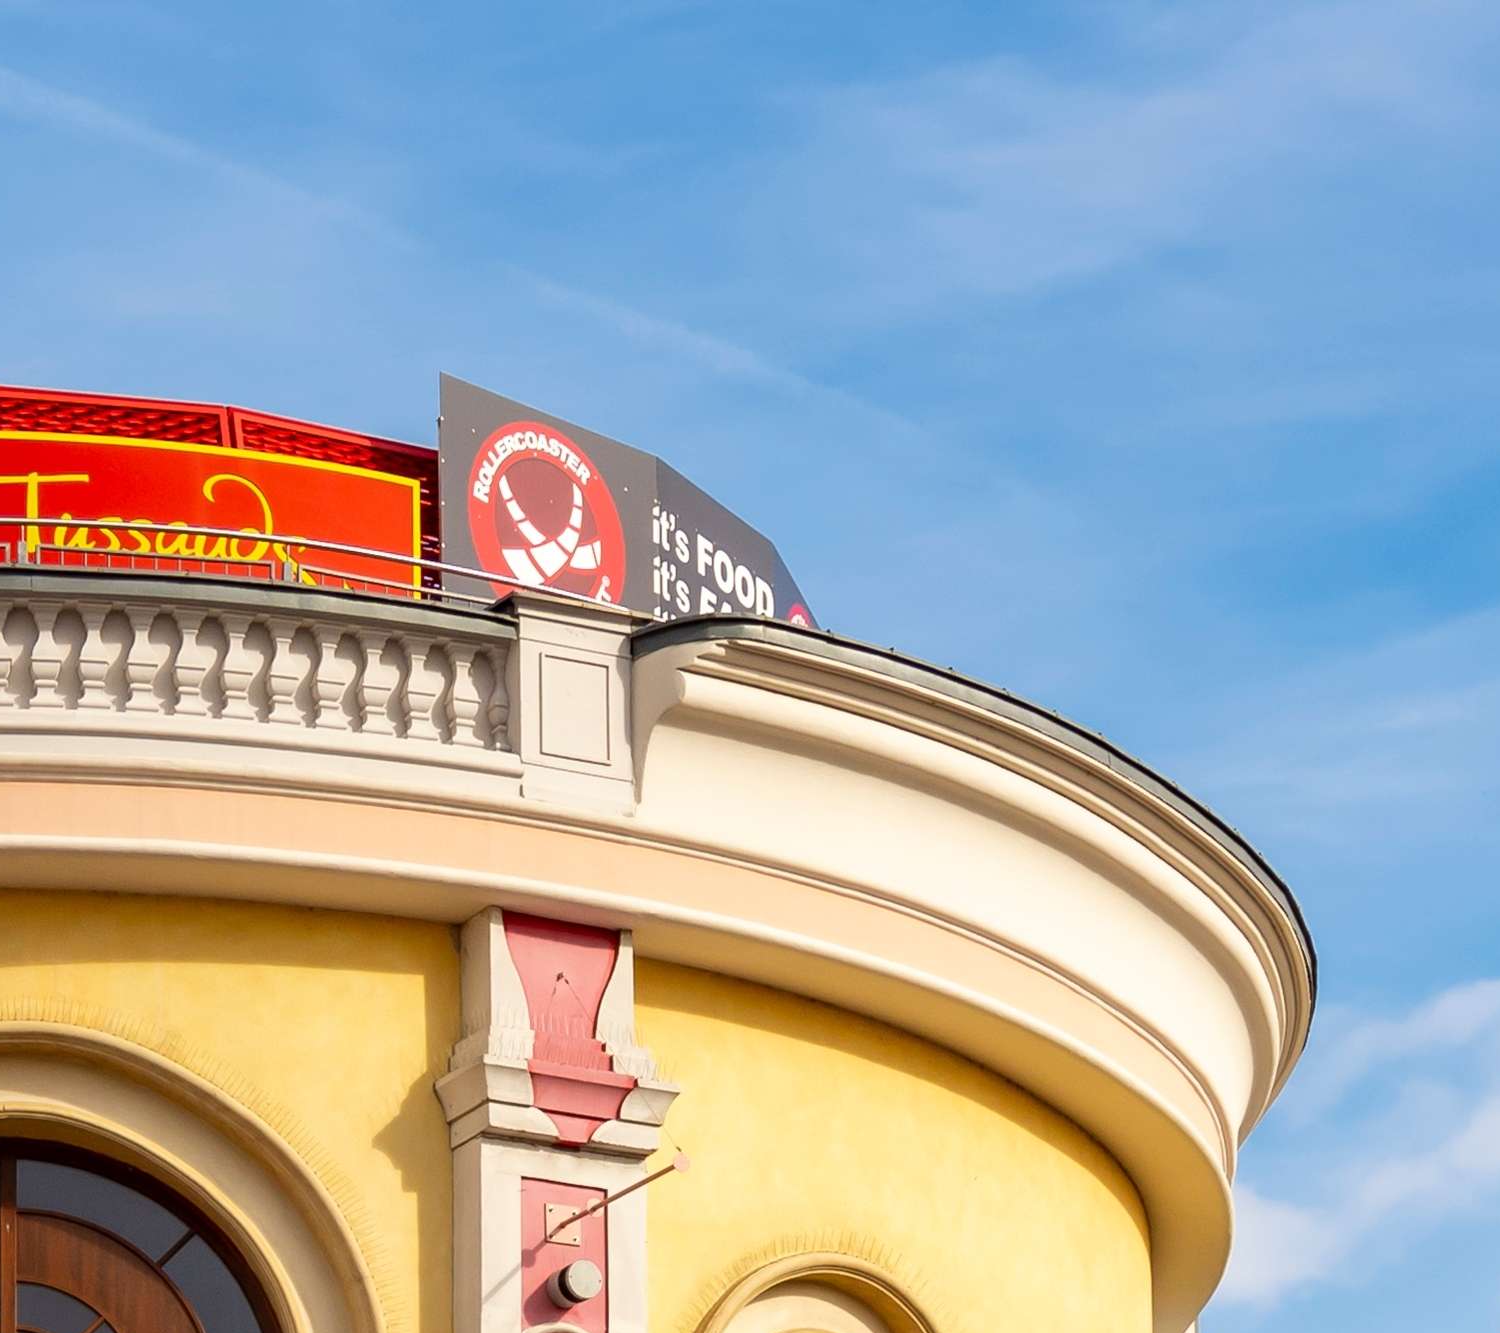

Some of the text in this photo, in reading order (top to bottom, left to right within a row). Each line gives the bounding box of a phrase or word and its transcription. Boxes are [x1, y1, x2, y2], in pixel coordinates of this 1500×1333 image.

[473, 431, 591, 504] ROLLERCOASTER
[652, 506, 690, 563] it's
[697, 534, 775, 617] FOOD
